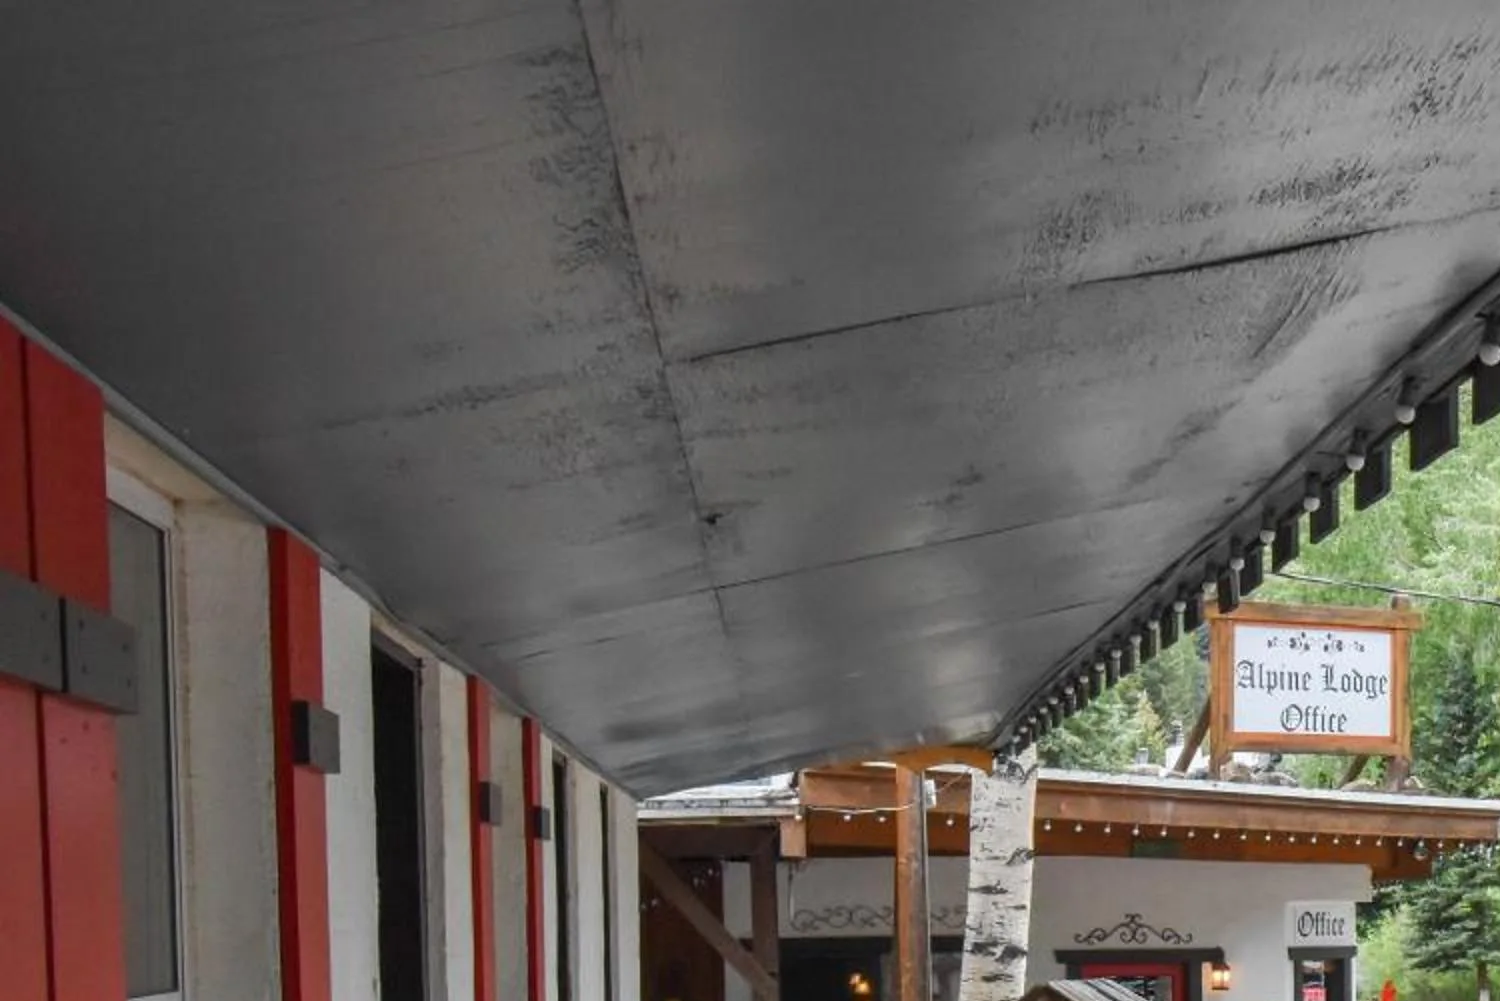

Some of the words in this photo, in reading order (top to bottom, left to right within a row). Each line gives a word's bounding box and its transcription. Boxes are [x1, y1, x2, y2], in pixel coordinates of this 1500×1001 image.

[1236, 659, 1312, 697] Alpine
[1321, 663, 1388, 700] Lodge
[1281, 703, 1347, 733] Office
[1297, 911, 1345, 938] Office
